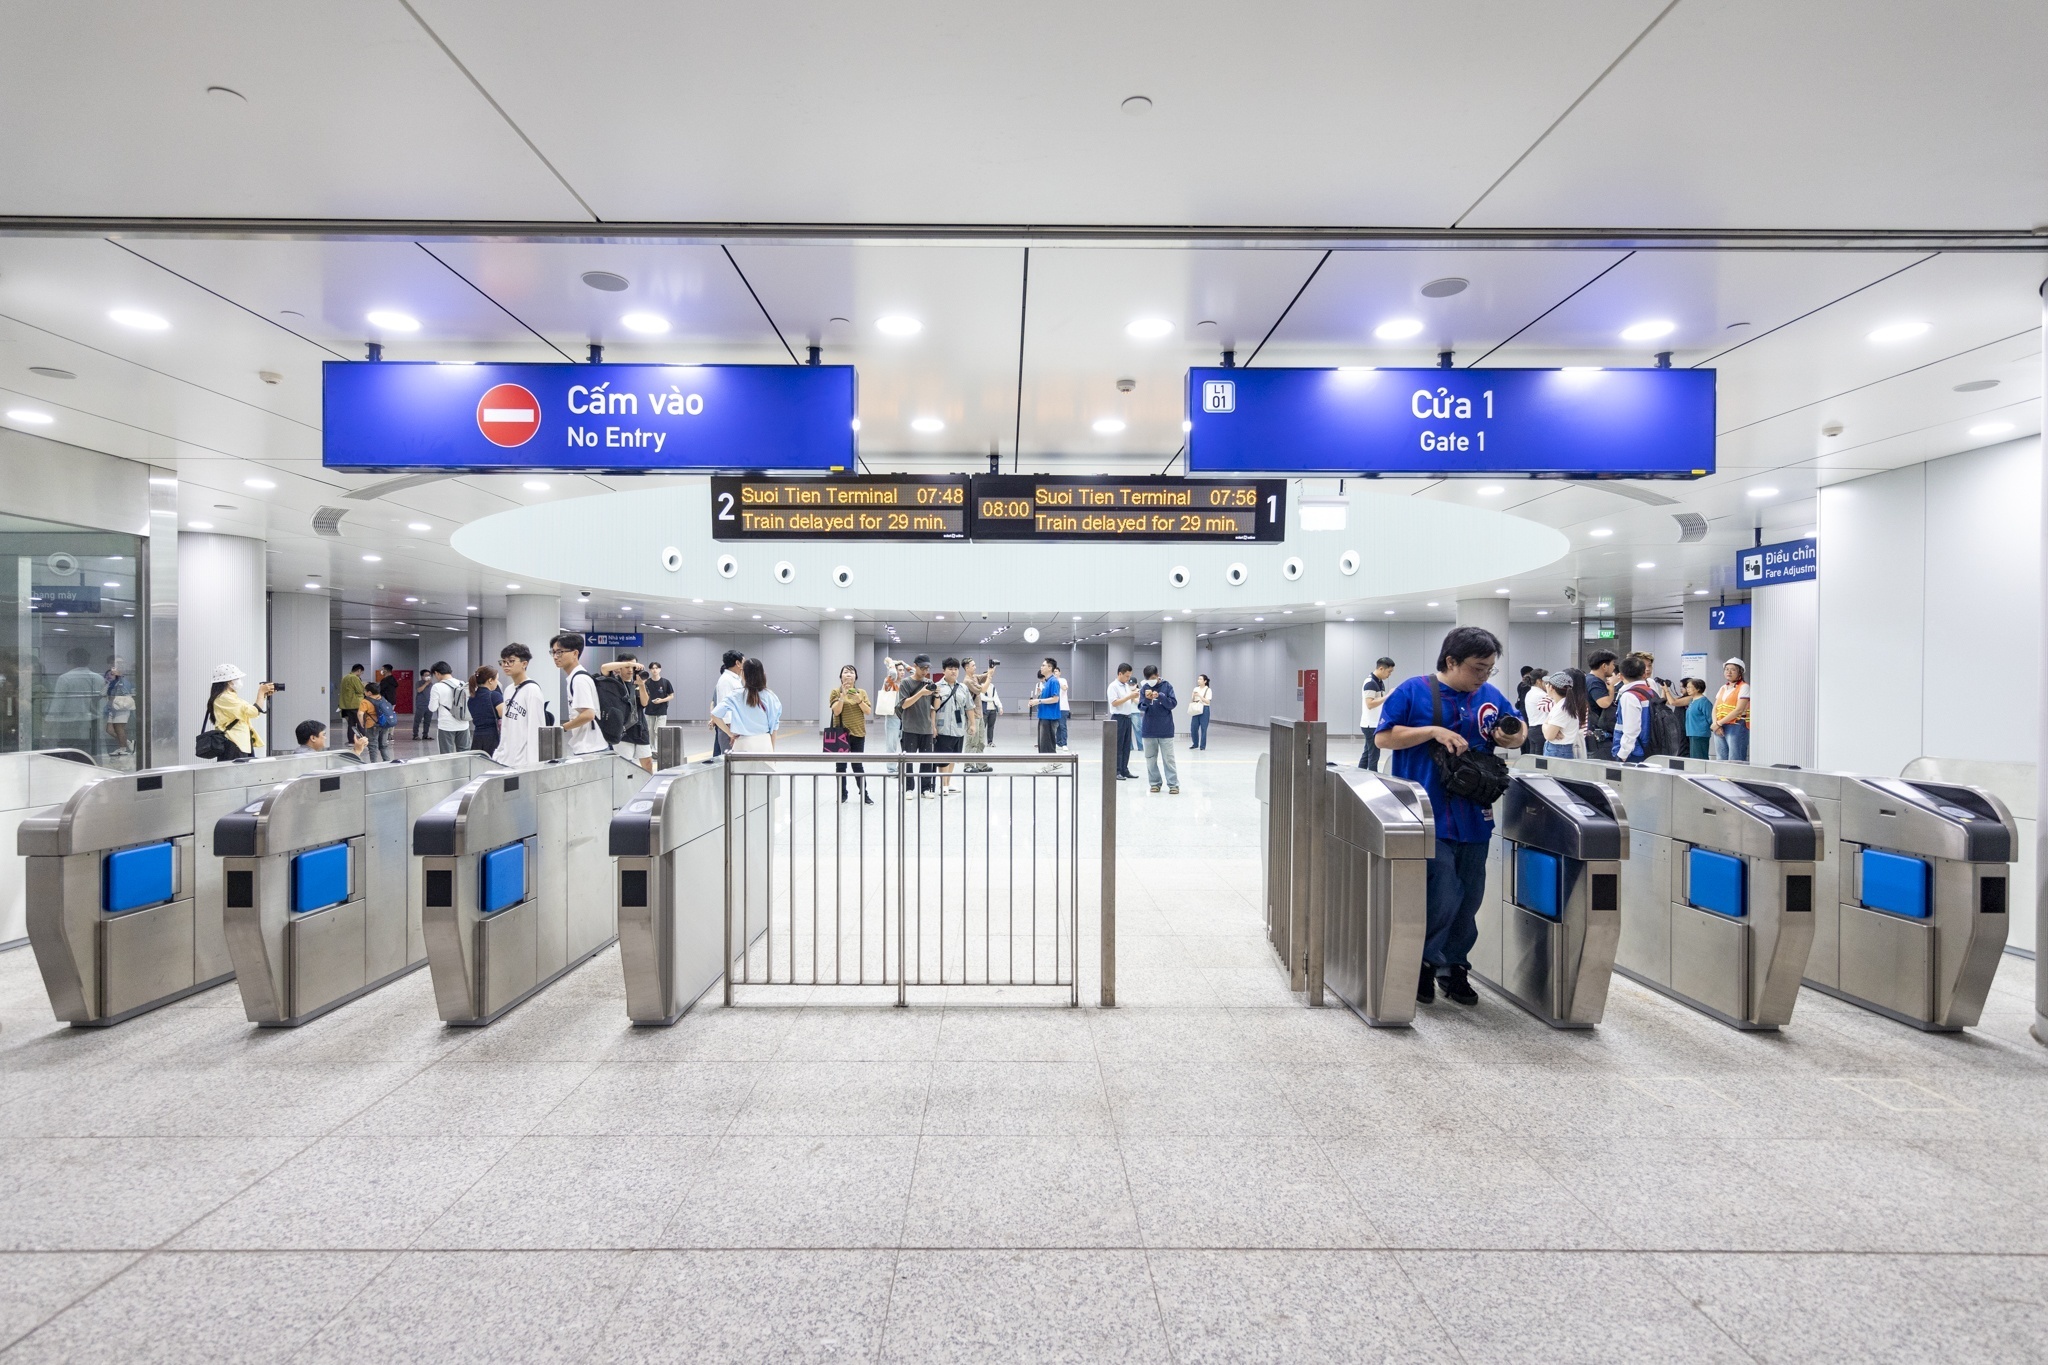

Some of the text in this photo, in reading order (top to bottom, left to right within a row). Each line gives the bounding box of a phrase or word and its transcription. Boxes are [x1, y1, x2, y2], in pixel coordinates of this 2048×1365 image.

[1214, 384, 1224, 394] L1
[568, 382, 704, 415] Cấm vào
[1212, 395, 1226, 409] 01
[1411, 387, 1493, 419] Cửa 1
[567, 427, 667, 453] No Entry
[1420, 430, 1484, 452] Gate 1
[741, 487, 964, 504] Suoi Tien Terminal 07:48
[1035, 488, 1257, 506] Suoi Tien Terminal 07:56
[718, 492, 735, 521] 2
[982, 501, 1029, 517] 08:00
[1266, 495, 1277, 523] 1
[742, 513, 947, 532] Train delayed for 29 min.
[1036, 514, 1238, 534] Train delayed for 29 min.
[1765, 549, 1790, 565] Điều
[1765, 568, 1782, 579] Fare
[58, 591, 77, 601] máy
[1718, 610, 1725, 625] 2
